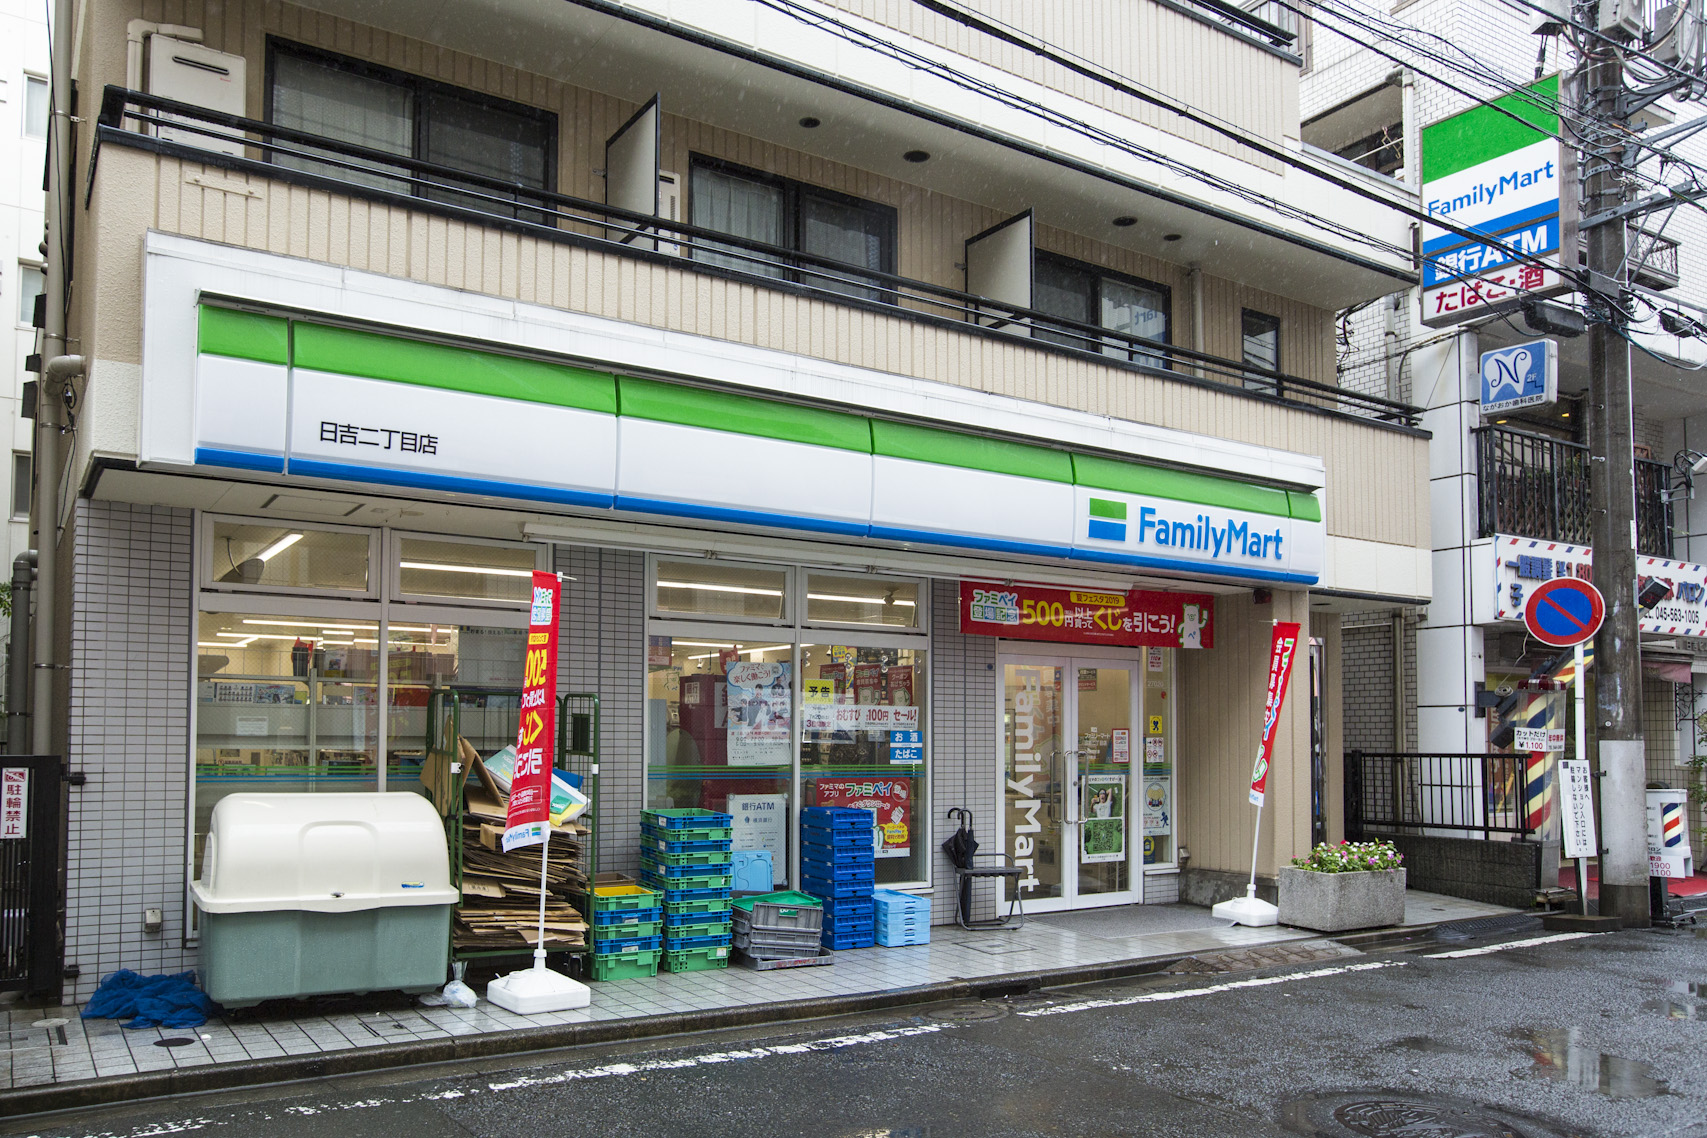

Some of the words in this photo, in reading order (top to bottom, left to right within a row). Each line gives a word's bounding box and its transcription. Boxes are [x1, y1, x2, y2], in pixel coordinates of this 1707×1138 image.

[1428, 160, 1554, 217] FamilyMart
[1434, 224, 1548, 281] 銀行ATM
[1436, 262, 1544, 314] たばこ・酒
[1526, 372, 1537, 382] 2F
[1482, 394, 1544, 412] ながおか歯科医院
[319, 420, 439, 456] 日吉二丁目店
[1137, 505, 1283, 561] FamilyMart
[974, 591, 1018, 606] ファミペイ
[972, 605, 1018, 623] 登場記念
[1655, 605, 1700, 624] 045-563-1005
[733, 670, 771, 684] 楽しく働こう!
[808, 686, 830, 698] 予告
[836, 708, 861, 721] おむすび
[893, 709, 917, 722] セール!
[1515, 730, 1546, 738] カットだけ
[894, 749, 918, 759] たばこ
[1007, 668, 1043, 893] FamilyMart
[1582, 766, 1591, 801] お客様へ
[845, 782, 893, 797] ファミペイ
[5, 784, 22, 835] 駐輪禁止
[741, 802, 775, 811] 銀行ATM
[1650, 862, 1671, 870] 1900
[1650, 869, 1672, 877] 1100
